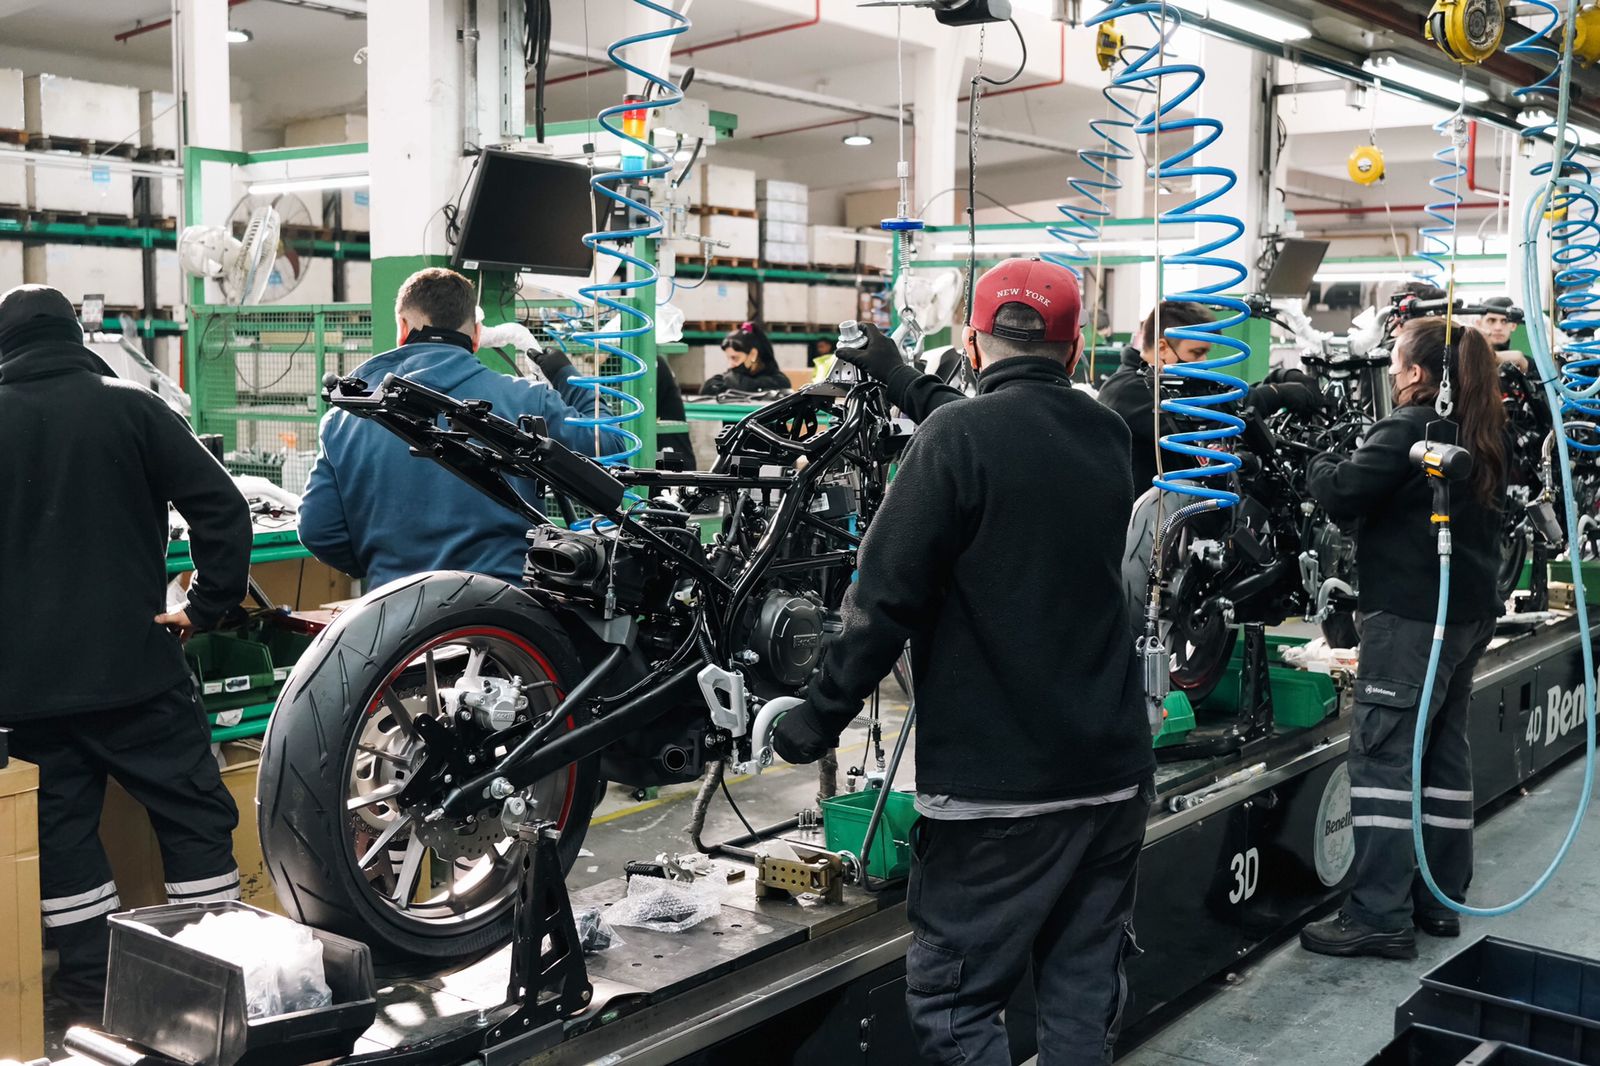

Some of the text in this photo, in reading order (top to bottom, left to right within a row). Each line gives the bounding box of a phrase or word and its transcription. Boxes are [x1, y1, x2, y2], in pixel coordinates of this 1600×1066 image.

[996, 288, 1051, 307] NEW YORK
[1525, 705, 1542, 747] 4D
[1229, 847, 1259, 904] 3D
